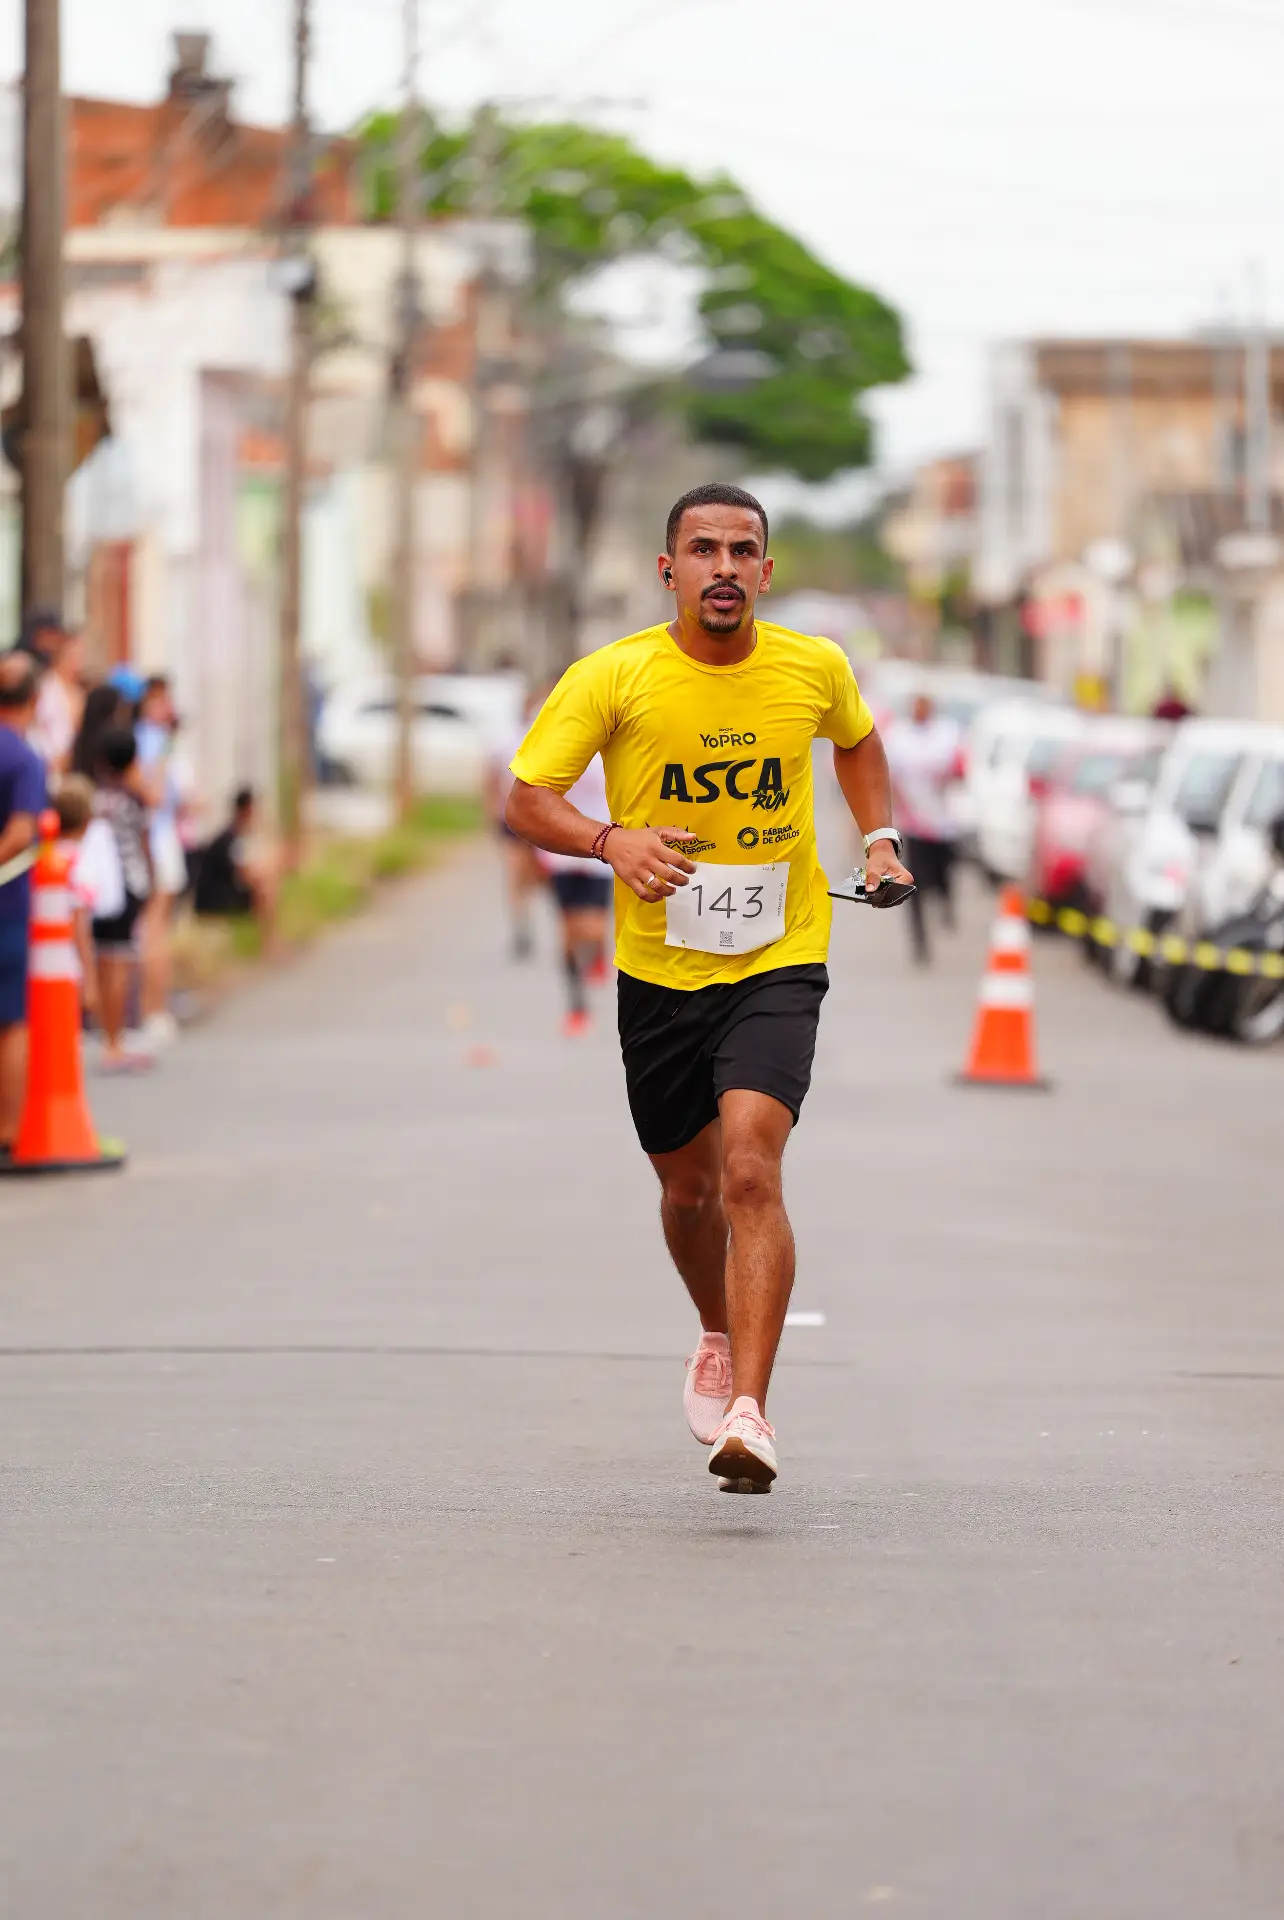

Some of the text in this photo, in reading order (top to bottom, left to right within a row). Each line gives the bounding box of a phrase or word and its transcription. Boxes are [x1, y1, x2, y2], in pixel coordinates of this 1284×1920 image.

[660, 757, 783, 803] ASCA
[751, 787, 790, 812] RUN
[762, 824, 793, 837] FÁBRICA
[775, 829, 800, 843] ÓCULOS
[686, 842, 717, 855] SPORTS
[691, 884, 764, 918] 143
